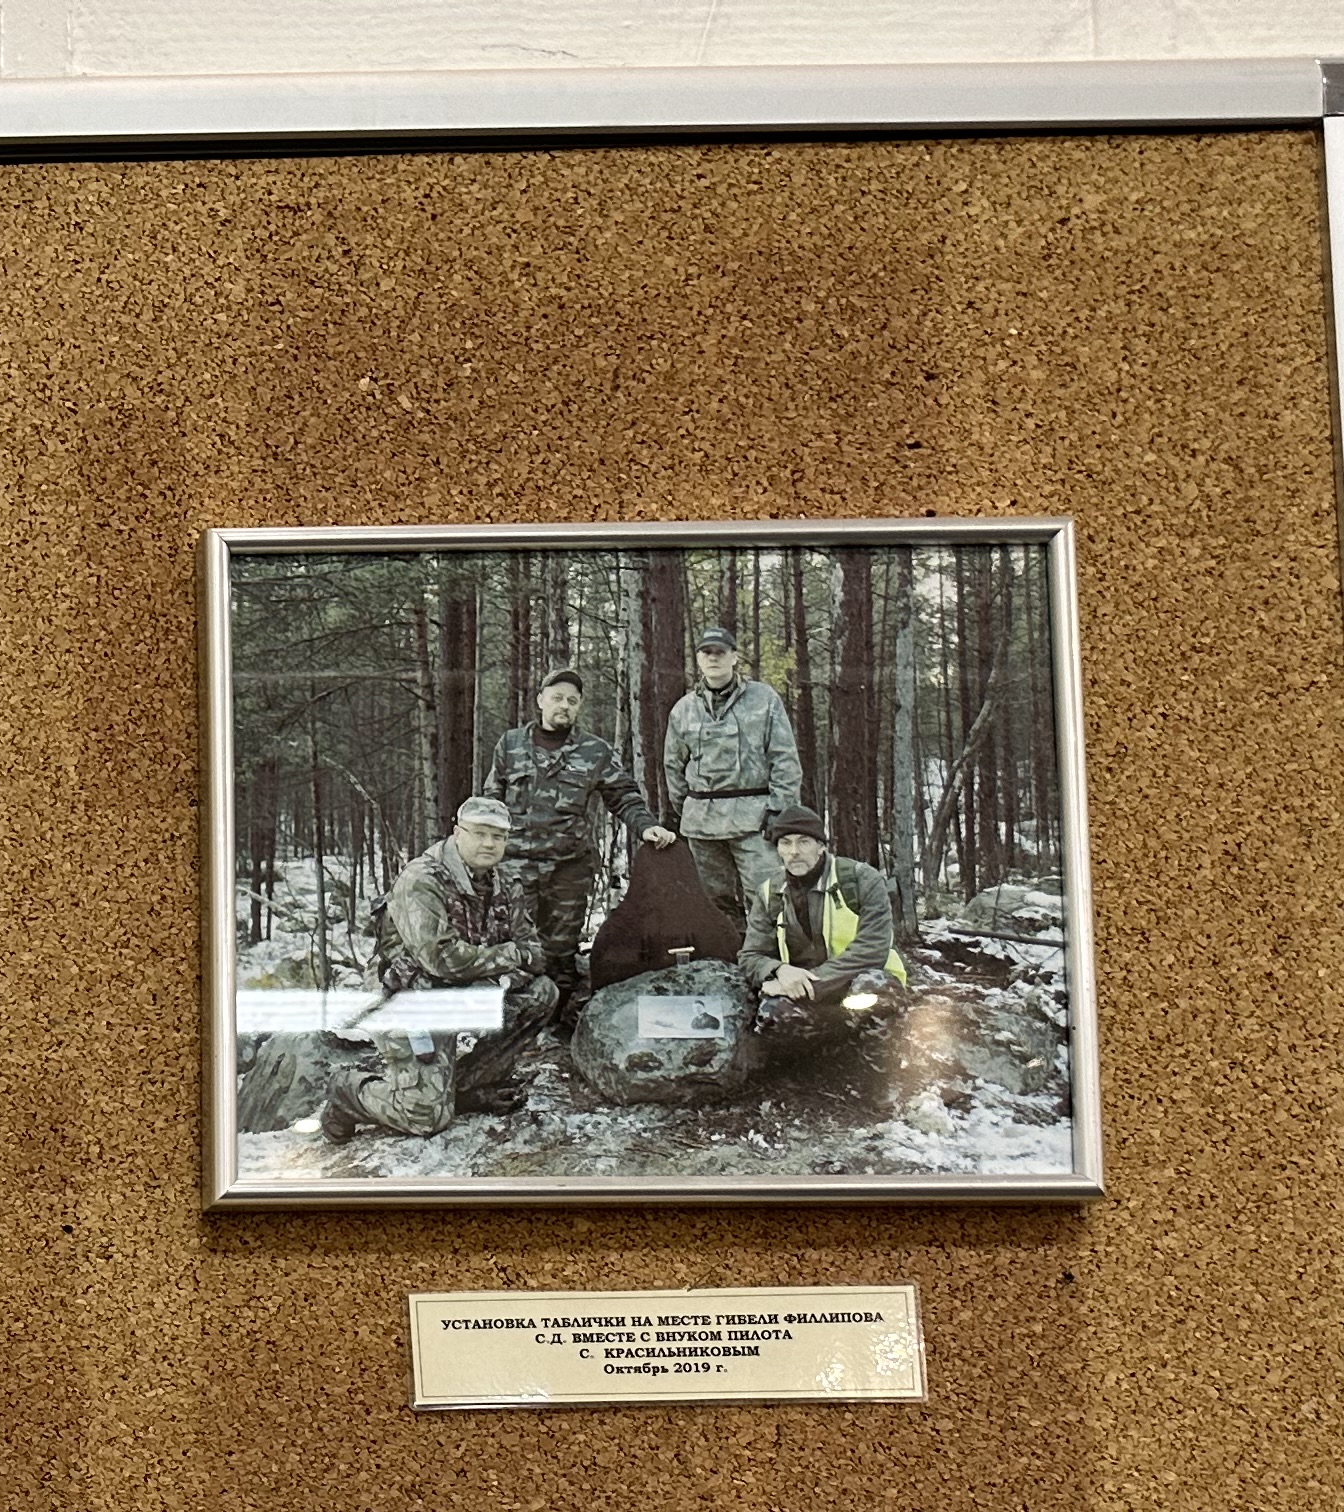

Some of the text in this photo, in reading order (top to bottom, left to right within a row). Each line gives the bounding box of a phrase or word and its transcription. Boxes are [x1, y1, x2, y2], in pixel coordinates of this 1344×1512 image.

[439, 1311, 886, 1331] УСТАНОВКА ТАБЛИЧКИ НА МЕСТЕ ГИБЕЛИ ФИЛЛИПОВА
[534, 1328, 794, 1346] С.Д. ВМЕСТЕ С ВНУКОМ ПИЛОТА
[578, 1344, 761, 1360] С. КРАСИЛЬНИКОВЫМ
[602, 1361, 729, 1376] Октябрь 2019 г.
